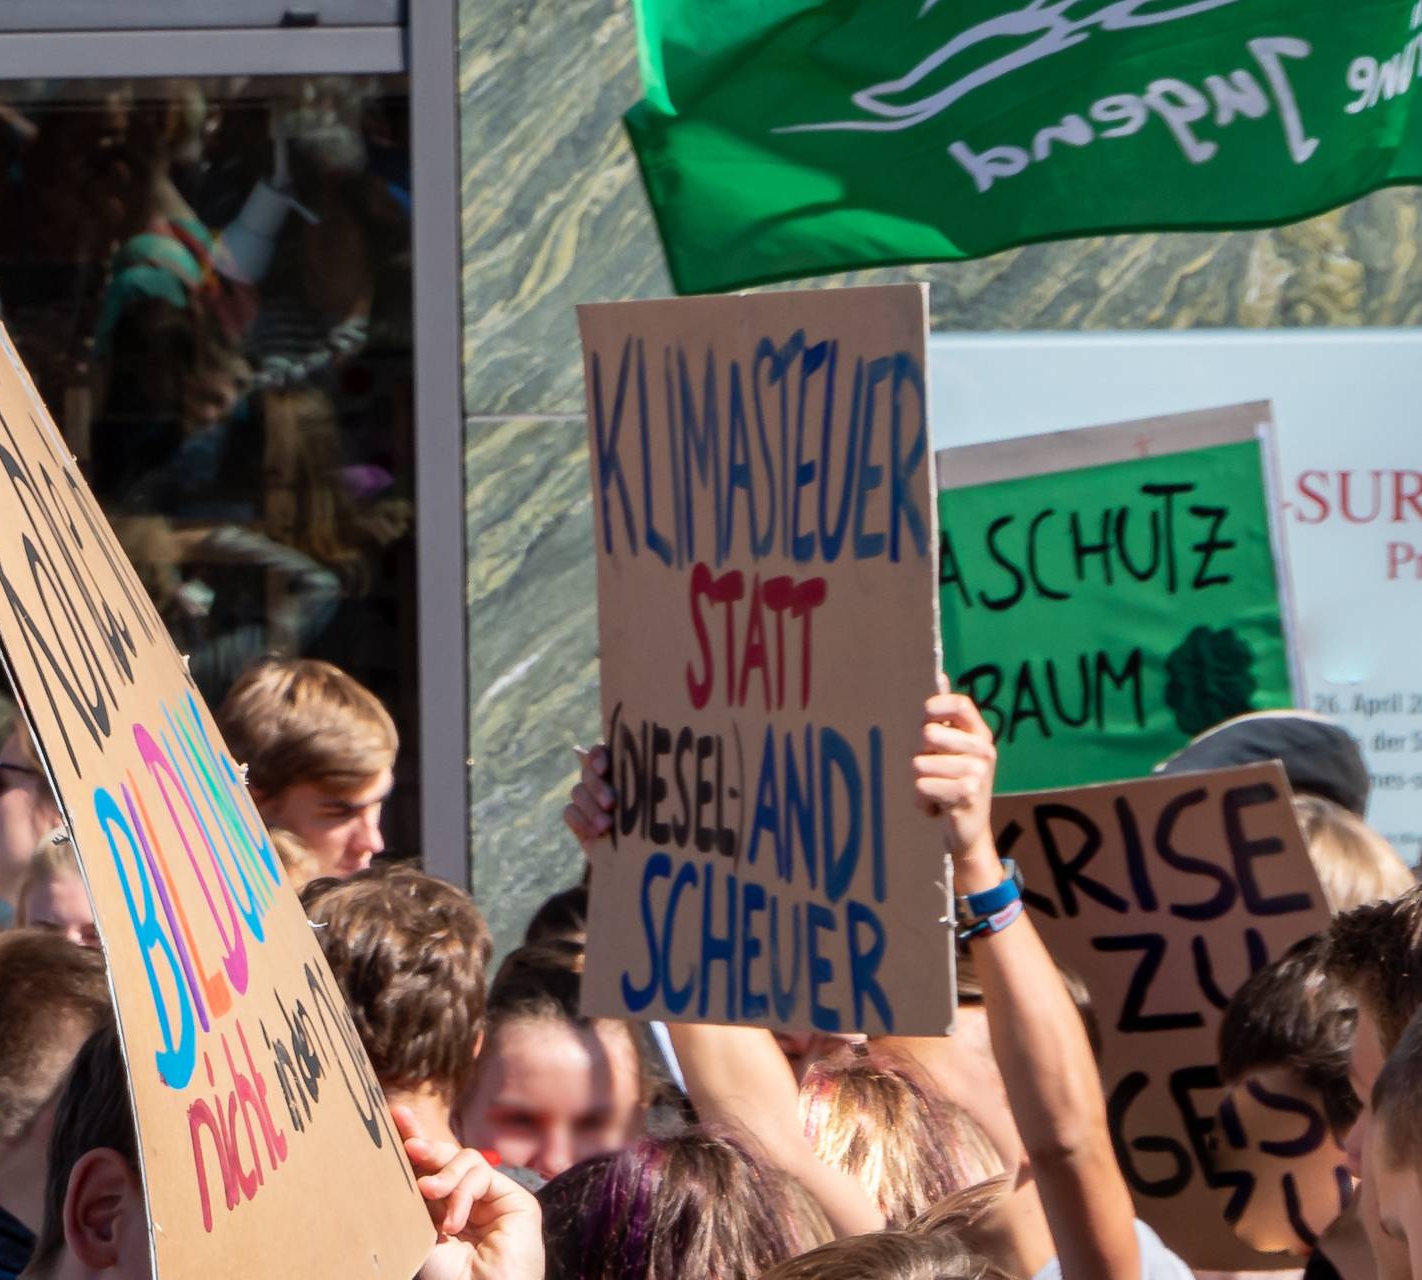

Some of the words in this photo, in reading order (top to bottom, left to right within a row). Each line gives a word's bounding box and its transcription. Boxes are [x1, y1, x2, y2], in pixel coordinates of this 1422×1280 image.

[592, 327, 930, 571] KLIMASTEUER
[685, 561, 827, 711] STATT
[956, 647, 1147, 745] BAUM
[93, 687, 281, 1090] BILDUNG
[621, 852, 894, 1033] SCHEUER
[186, 1018, 289, 1234] nicht
